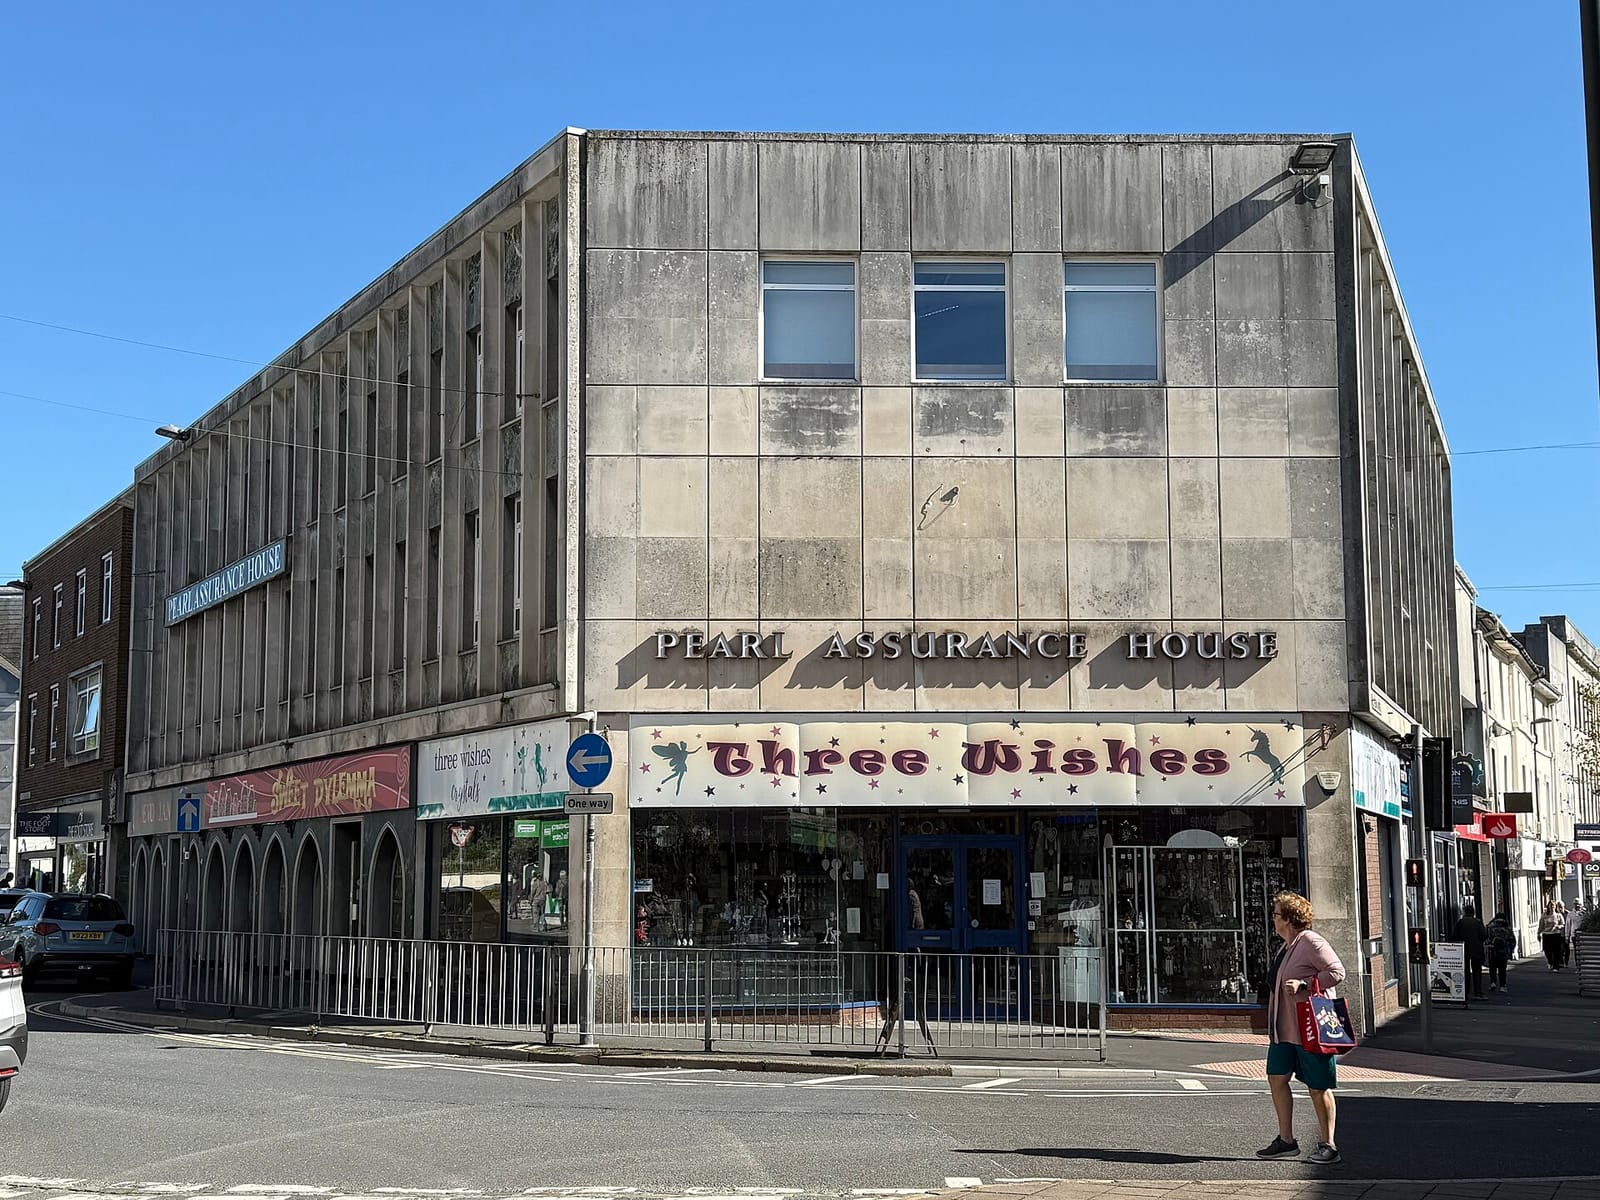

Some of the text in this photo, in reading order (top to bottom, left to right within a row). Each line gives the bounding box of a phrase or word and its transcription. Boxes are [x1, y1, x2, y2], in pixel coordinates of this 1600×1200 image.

[167, 544, 281, 622] PEARL ASSURANCE HOUSE
[654, 630, 1279, 660] PEARL ASSURANCE HOUSE
[434, 741, 491, 771] three wishes
[706, 738, 1231, 778] Three Wishes
[271, 766, 376, 815] SWEET DYLEMMA
[568, 799, 609, 809] One way
[1585, 864, 1600, 872] GO
